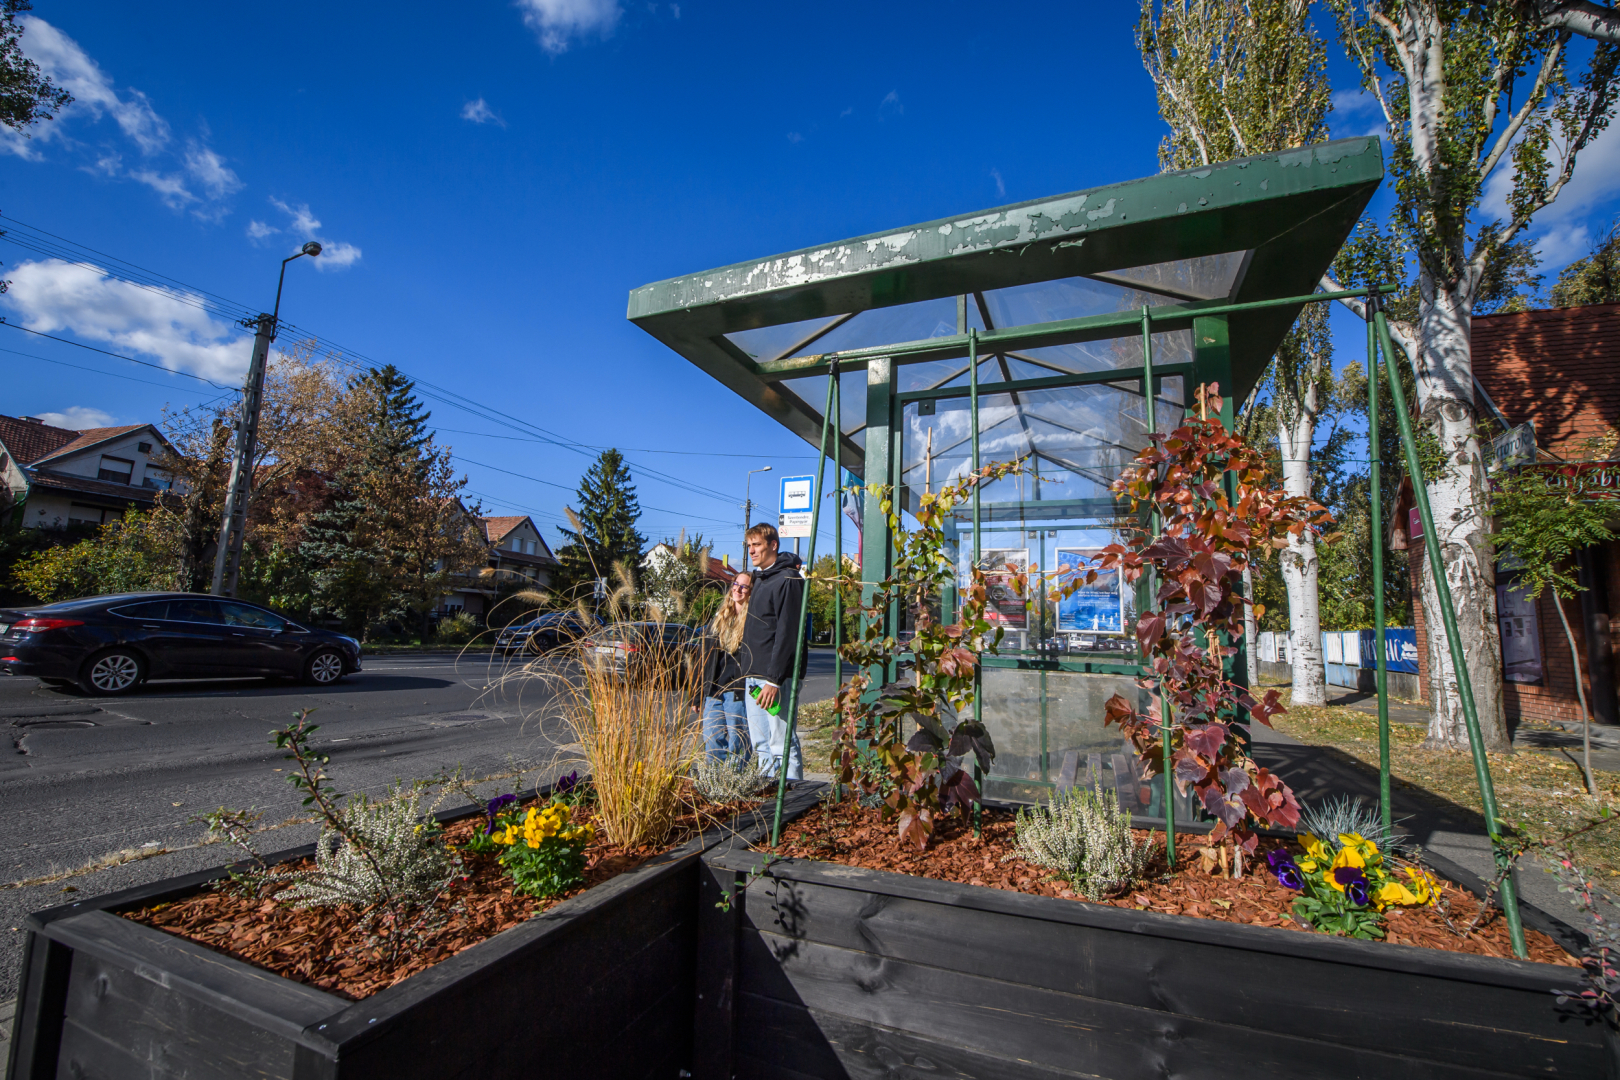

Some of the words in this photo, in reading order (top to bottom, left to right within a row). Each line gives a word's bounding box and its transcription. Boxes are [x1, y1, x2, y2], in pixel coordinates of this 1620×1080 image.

[1483, 432, 1533, 463] torok
[1536, 468, 1620, 495] enyőb
[1363, 639, 1402, 662] MARAC
